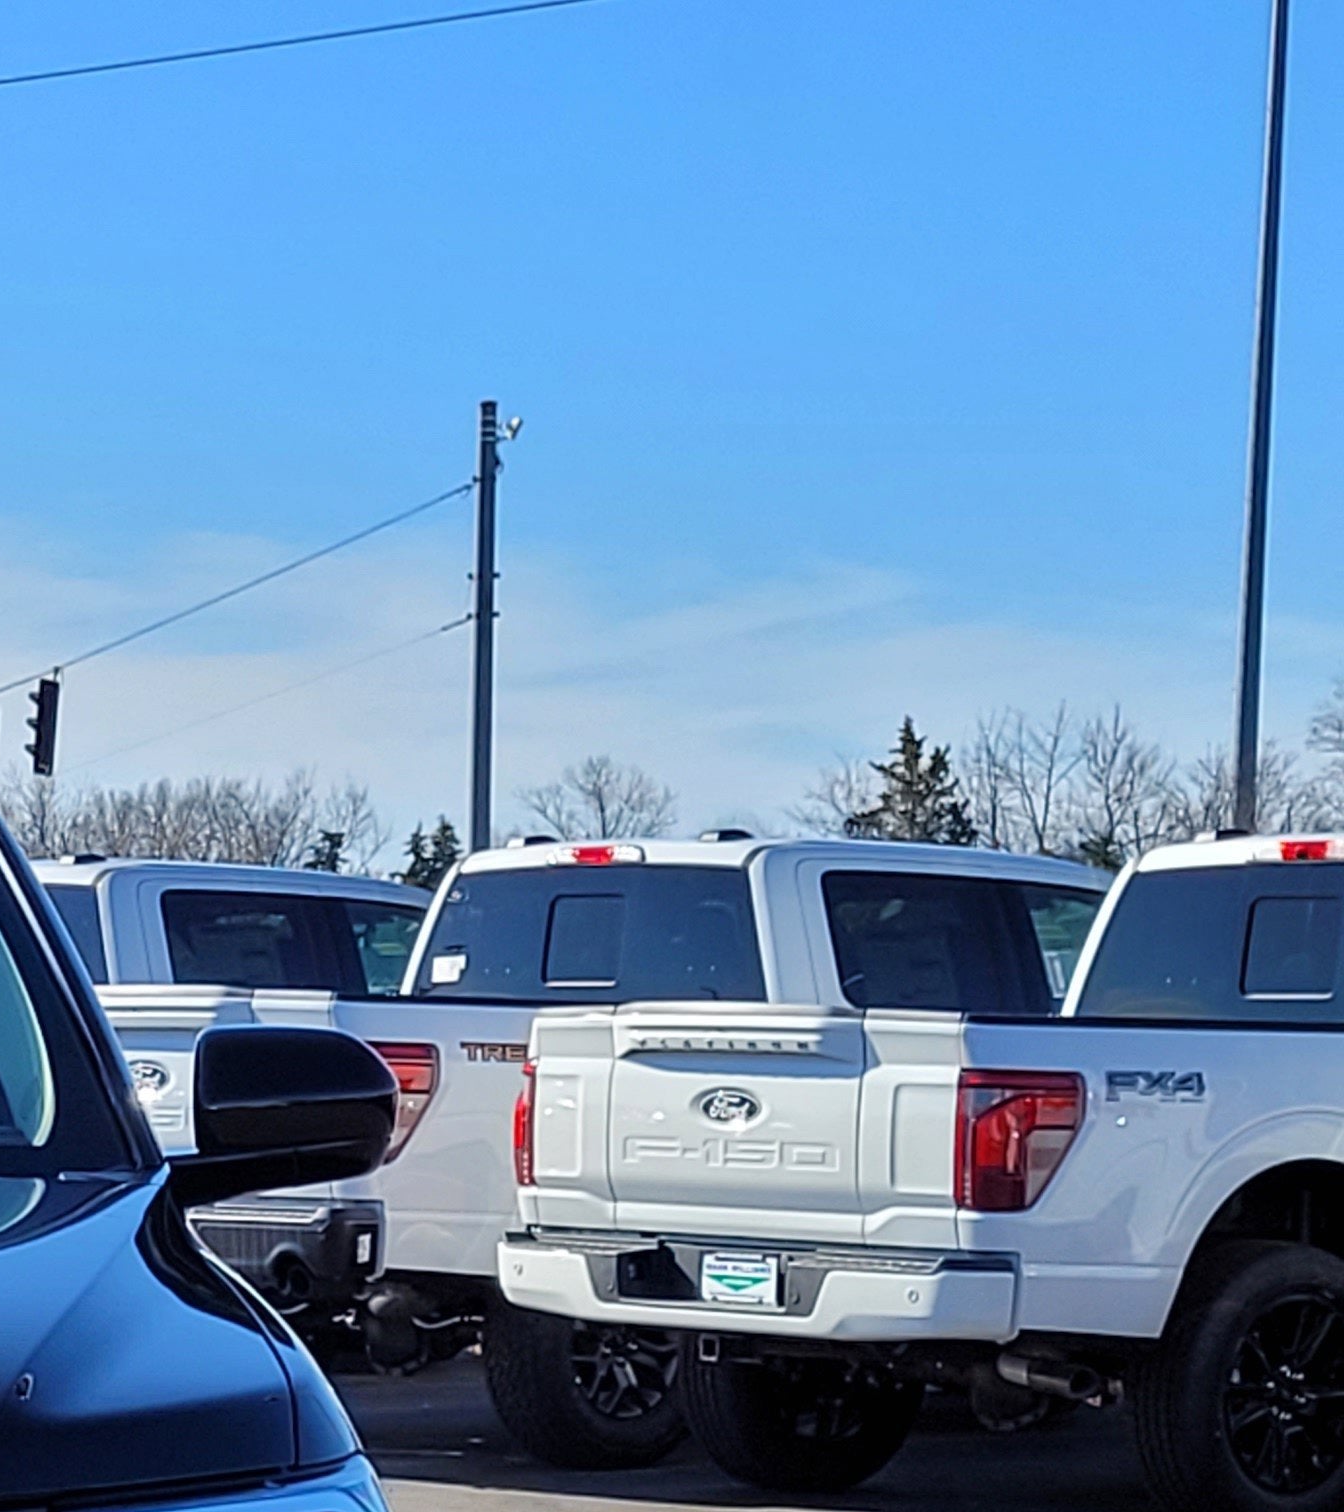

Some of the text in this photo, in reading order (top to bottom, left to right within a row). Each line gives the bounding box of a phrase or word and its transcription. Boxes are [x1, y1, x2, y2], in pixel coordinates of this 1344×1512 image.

[460, 1042, 528, 1063] TRE
[1105, 1070, 1206, 1103] FX4
[622, 1135, 841, 1173] F-150
